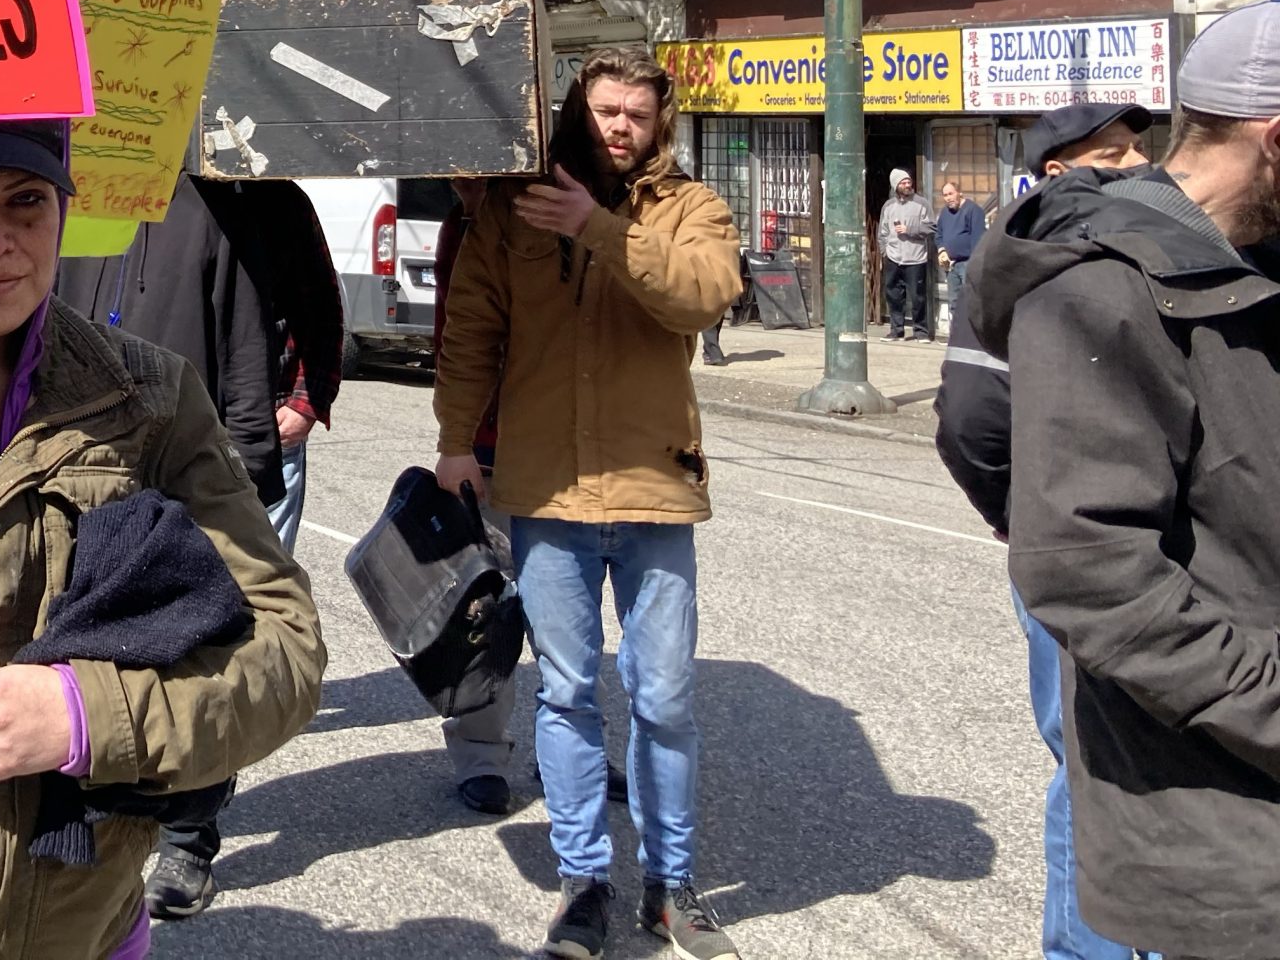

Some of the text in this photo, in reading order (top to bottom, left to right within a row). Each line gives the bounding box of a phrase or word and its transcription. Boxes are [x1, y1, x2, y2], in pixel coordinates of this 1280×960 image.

[989, 25, 1137, 62] BELMONT INN
[728, 45, 874, 85] Conveniee
[882, 41, 949, 82] Store
[987, 61, 1144, 83] Student Residence
[92, 70, 160, 104] Survive
[764, 93, 797, 106] Groceries
[904, 90, 951, 105] Stationeries
[1020, 90, 1137, 106] Ph: 604-633-3998
[104, 183, 153, 216] People
